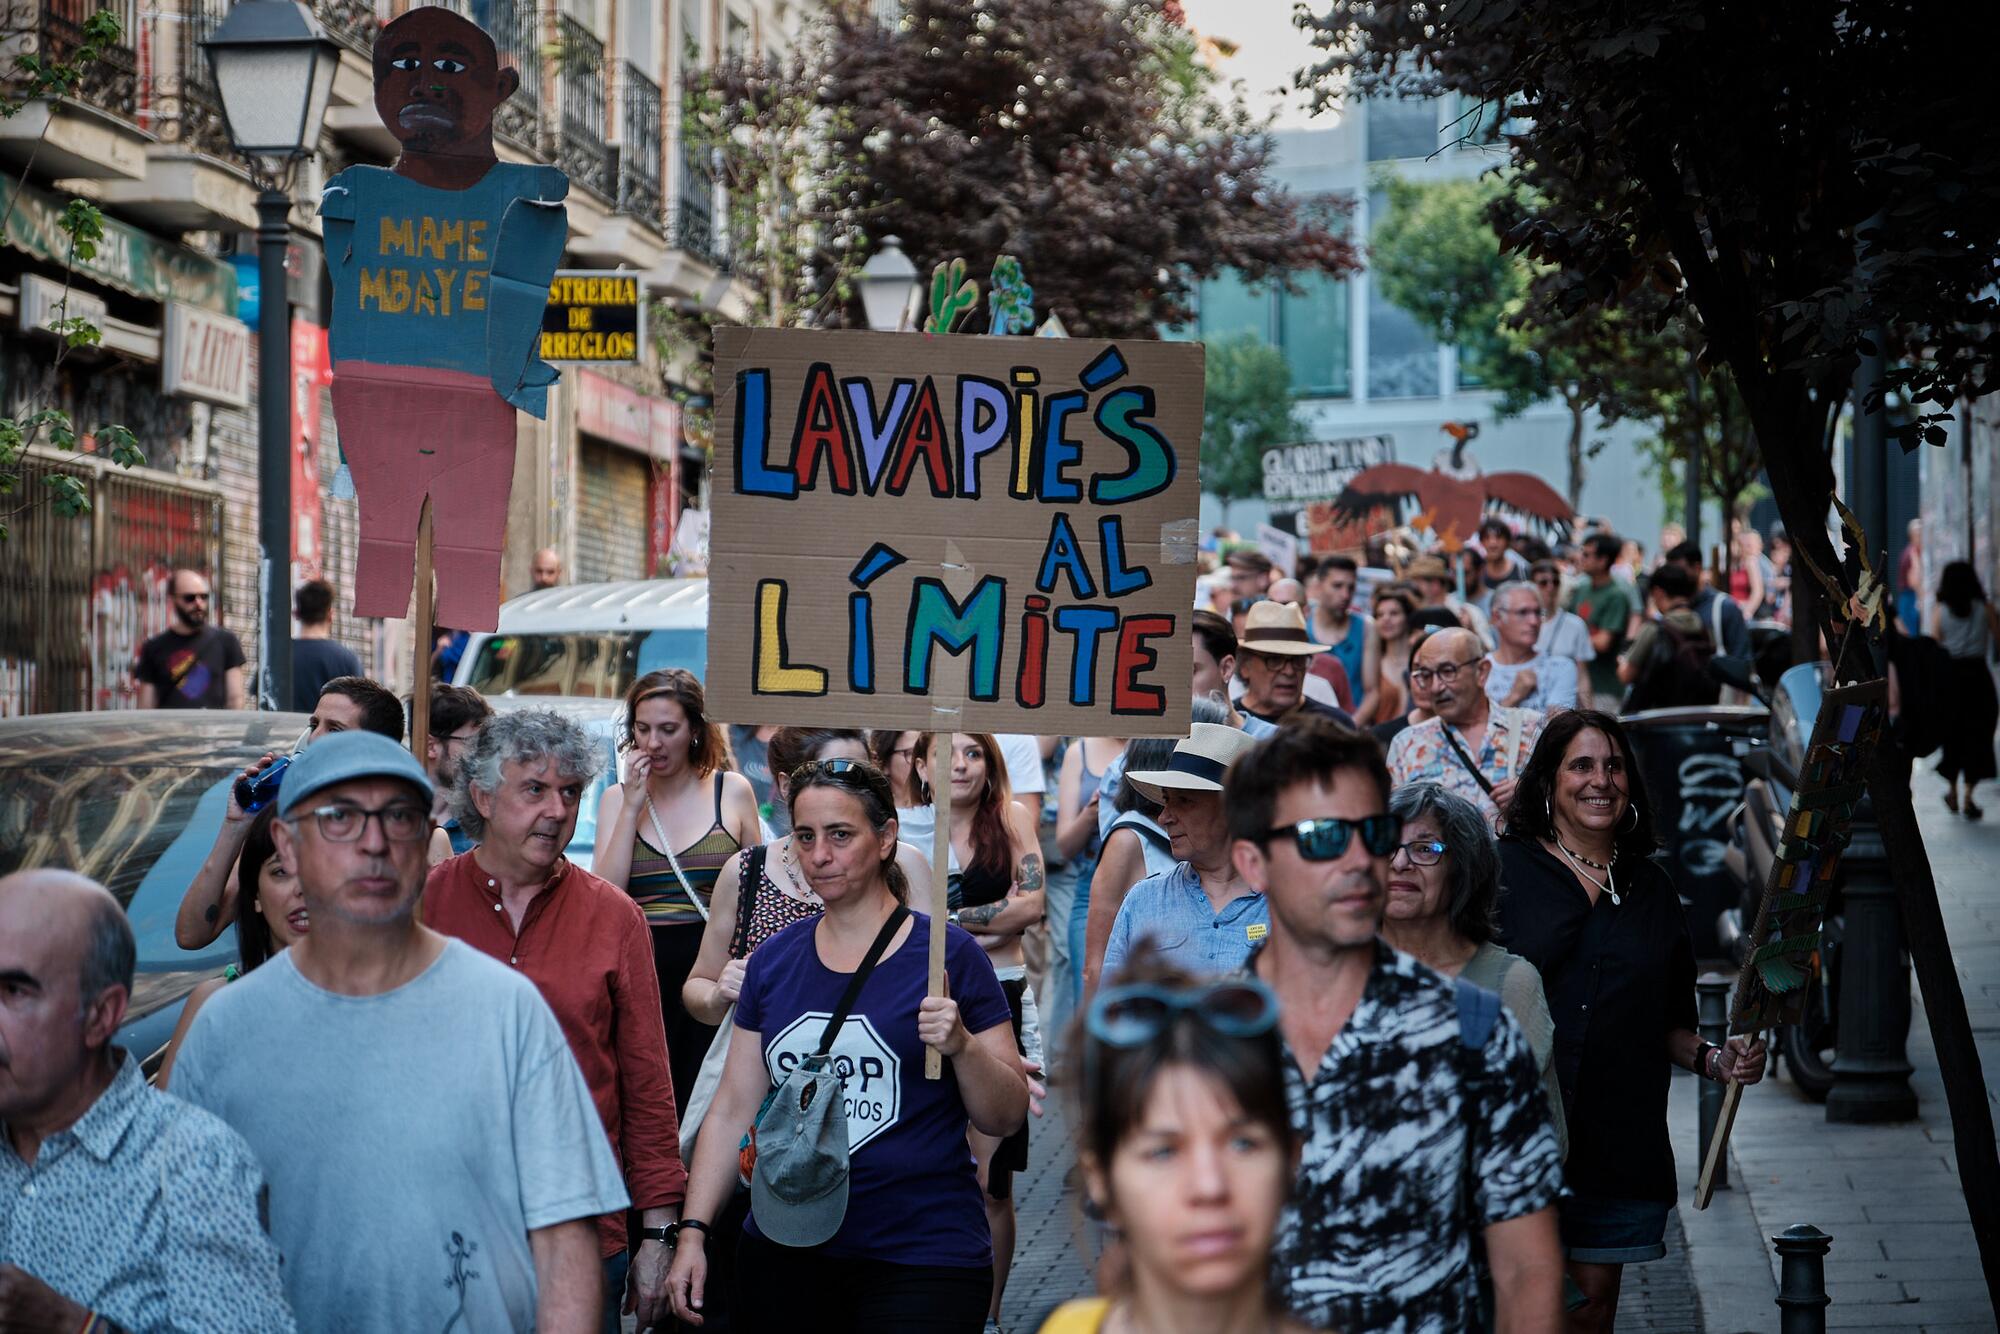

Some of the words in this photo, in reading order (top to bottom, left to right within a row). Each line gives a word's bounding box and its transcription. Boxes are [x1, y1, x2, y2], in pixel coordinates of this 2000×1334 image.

[379, 216, 488, 262] MAME
[359, 267, 488, 317] MBAYE
[547, 276, 637, 305] STRERIA
[567, 306, 592, 330] DE
[539, 331, 635, 360] RREGLOS
[1036, 511, 1153, 599] AL
[777, 1051, 884, 1093] SOP
[843, 1098, 883, 1122] CIOS
